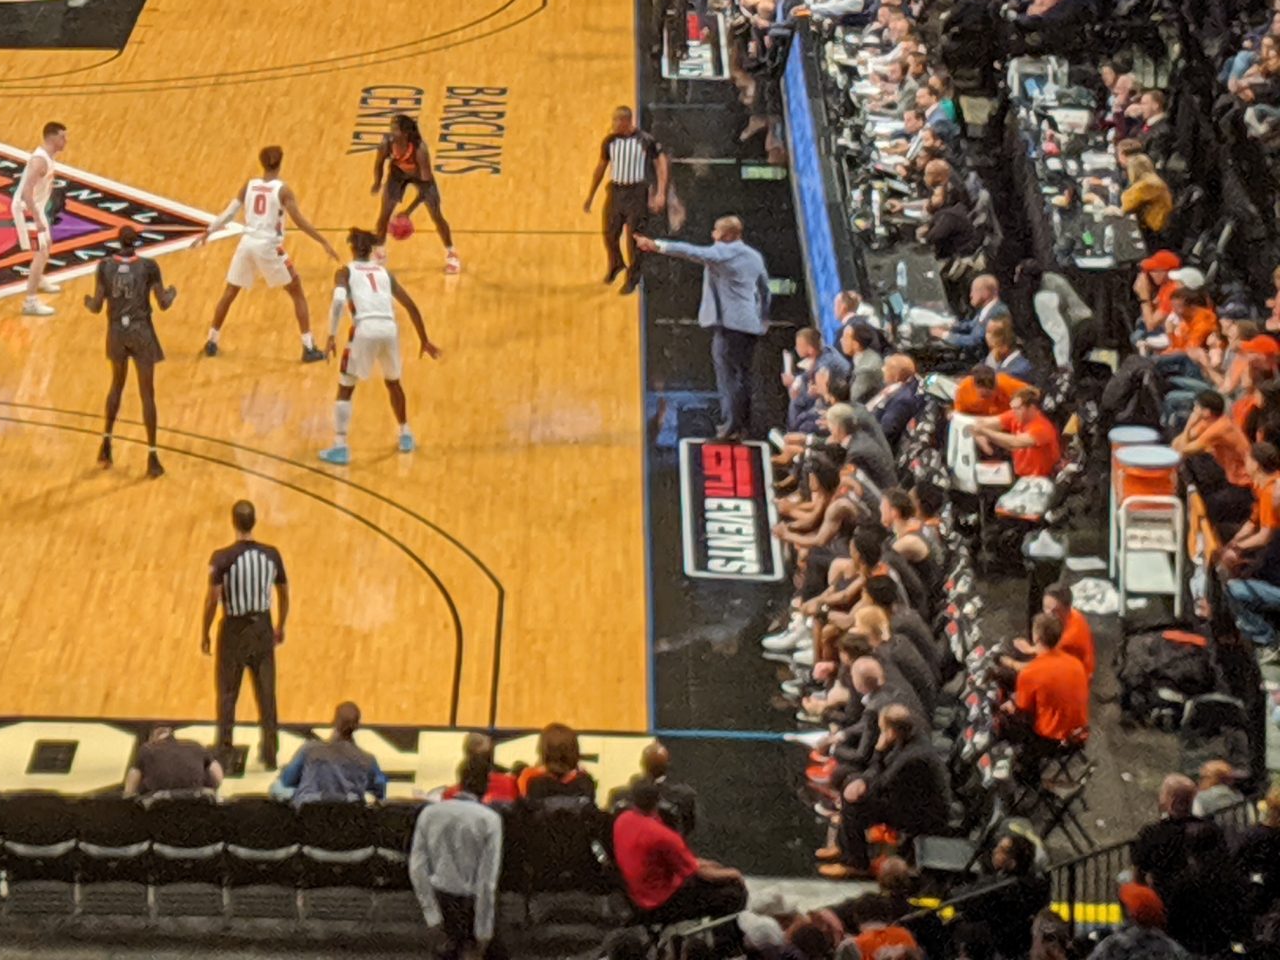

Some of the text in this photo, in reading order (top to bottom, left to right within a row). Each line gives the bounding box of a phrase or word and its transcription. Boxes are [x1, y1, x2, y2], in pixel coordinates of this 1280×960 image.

[346, 84, 424, 155] CENT
[434, 86, 508, 175] BARCLAYS
[253, 194, 266, 215] 0
[366, 272, 378, 293] 1
[704, 498, 760, 574] EVENTS
